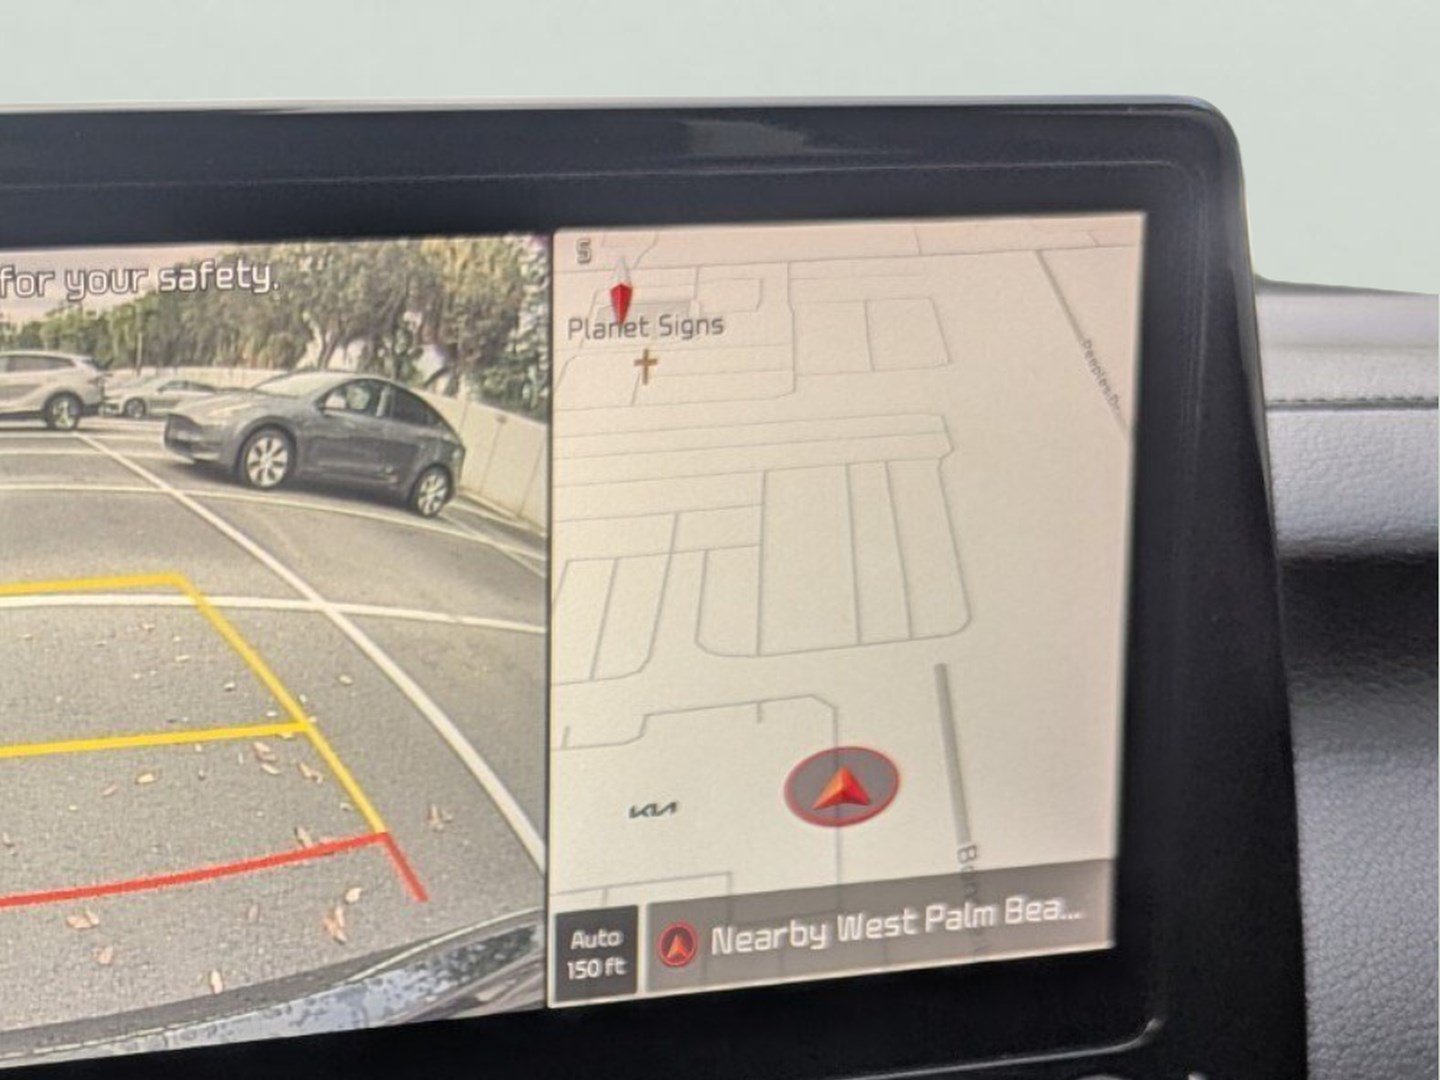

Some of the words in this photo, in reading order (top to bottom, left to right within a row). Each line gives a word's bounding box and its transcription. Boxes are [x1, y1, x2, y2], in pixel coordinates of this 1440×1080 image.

[64, 268, 149, 301] your
[157, 257, 280, 294] safety.
[567, 315, 651, 341] Planet
[658, 313, 725, 340] Signs
[570, 928, 623, 950] Auto
[710, 921, 829, 956] Nearby
[837, 907, 920, 942] West
[925, 901, 998, 934] Palm
[566, 958, 602, 980] 150
[605, 956, 627, 976] ft
